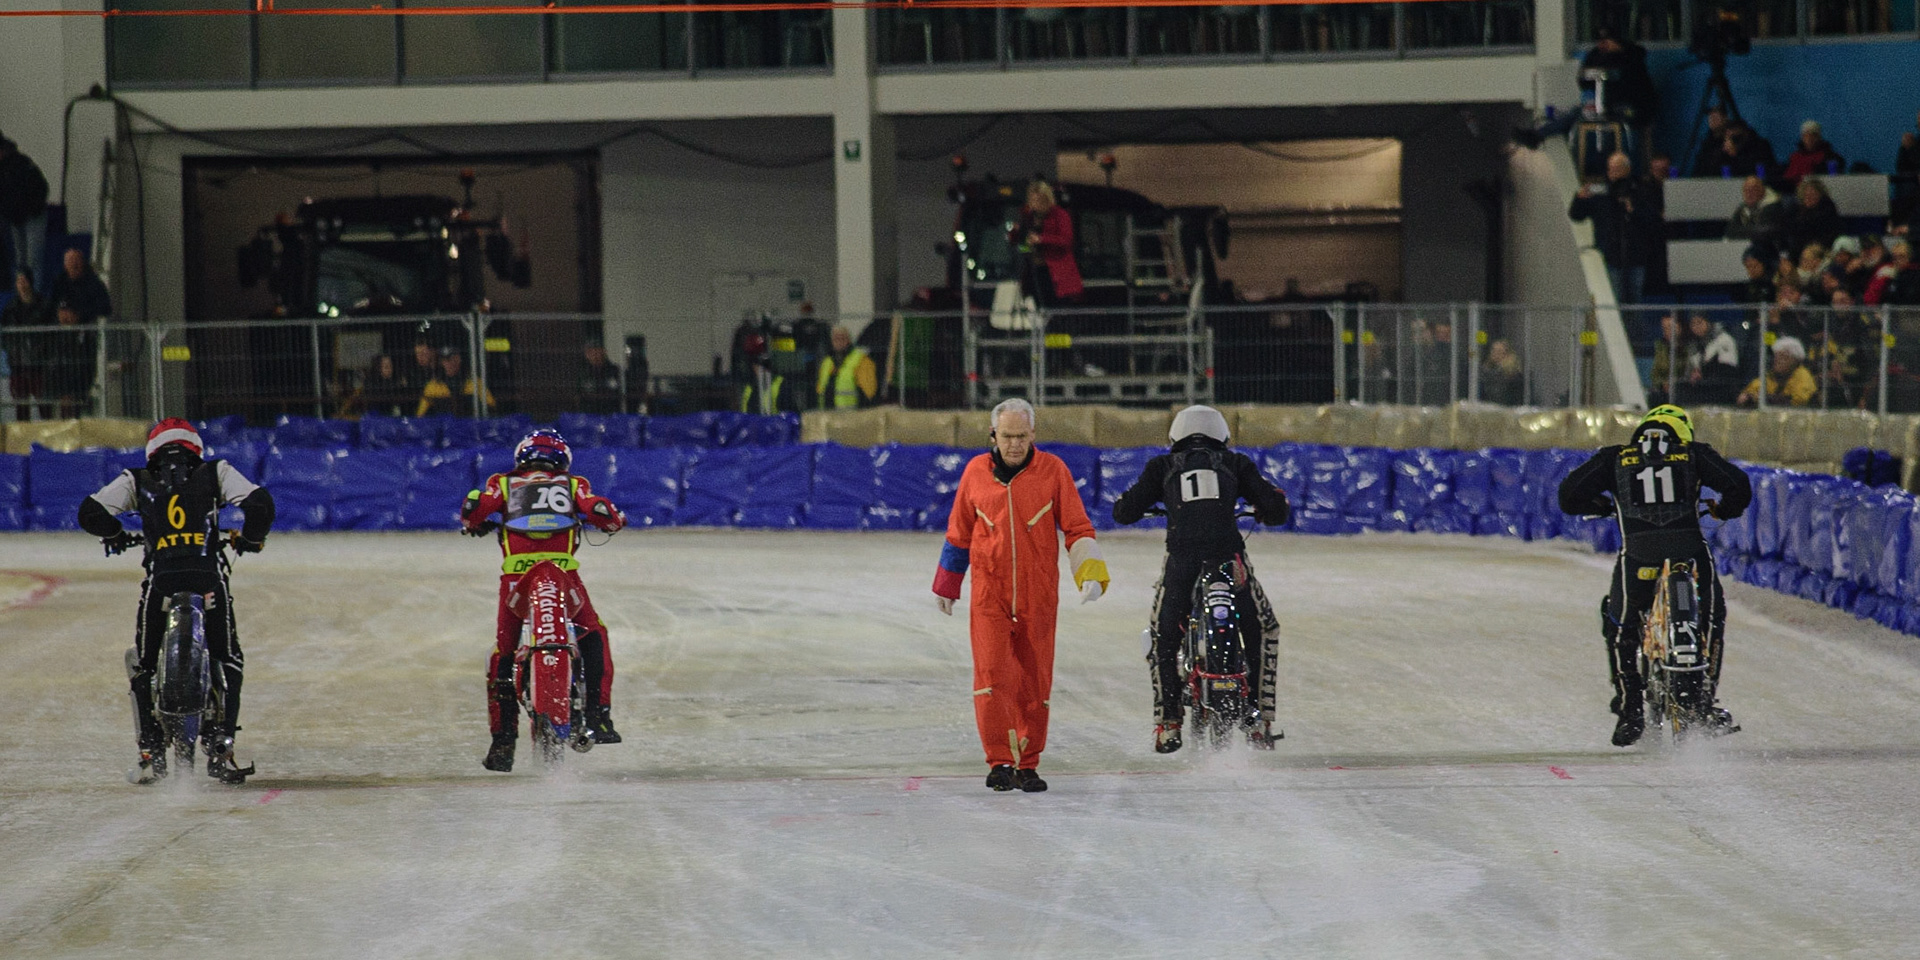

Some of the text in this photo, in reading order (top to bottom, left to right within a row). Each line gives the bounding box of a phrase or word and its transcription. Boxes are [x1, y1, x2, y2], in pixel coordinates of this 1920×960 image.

[531, 485, 573, 513] 16
[1186, 472, 1199, 498] 1
[1636, 466, 1675, 503] 11
[167, 494, 186, 530] 6
[156, 532, 205, 550] ATTE
[1260, 638, 1279, 712] LEHTI
